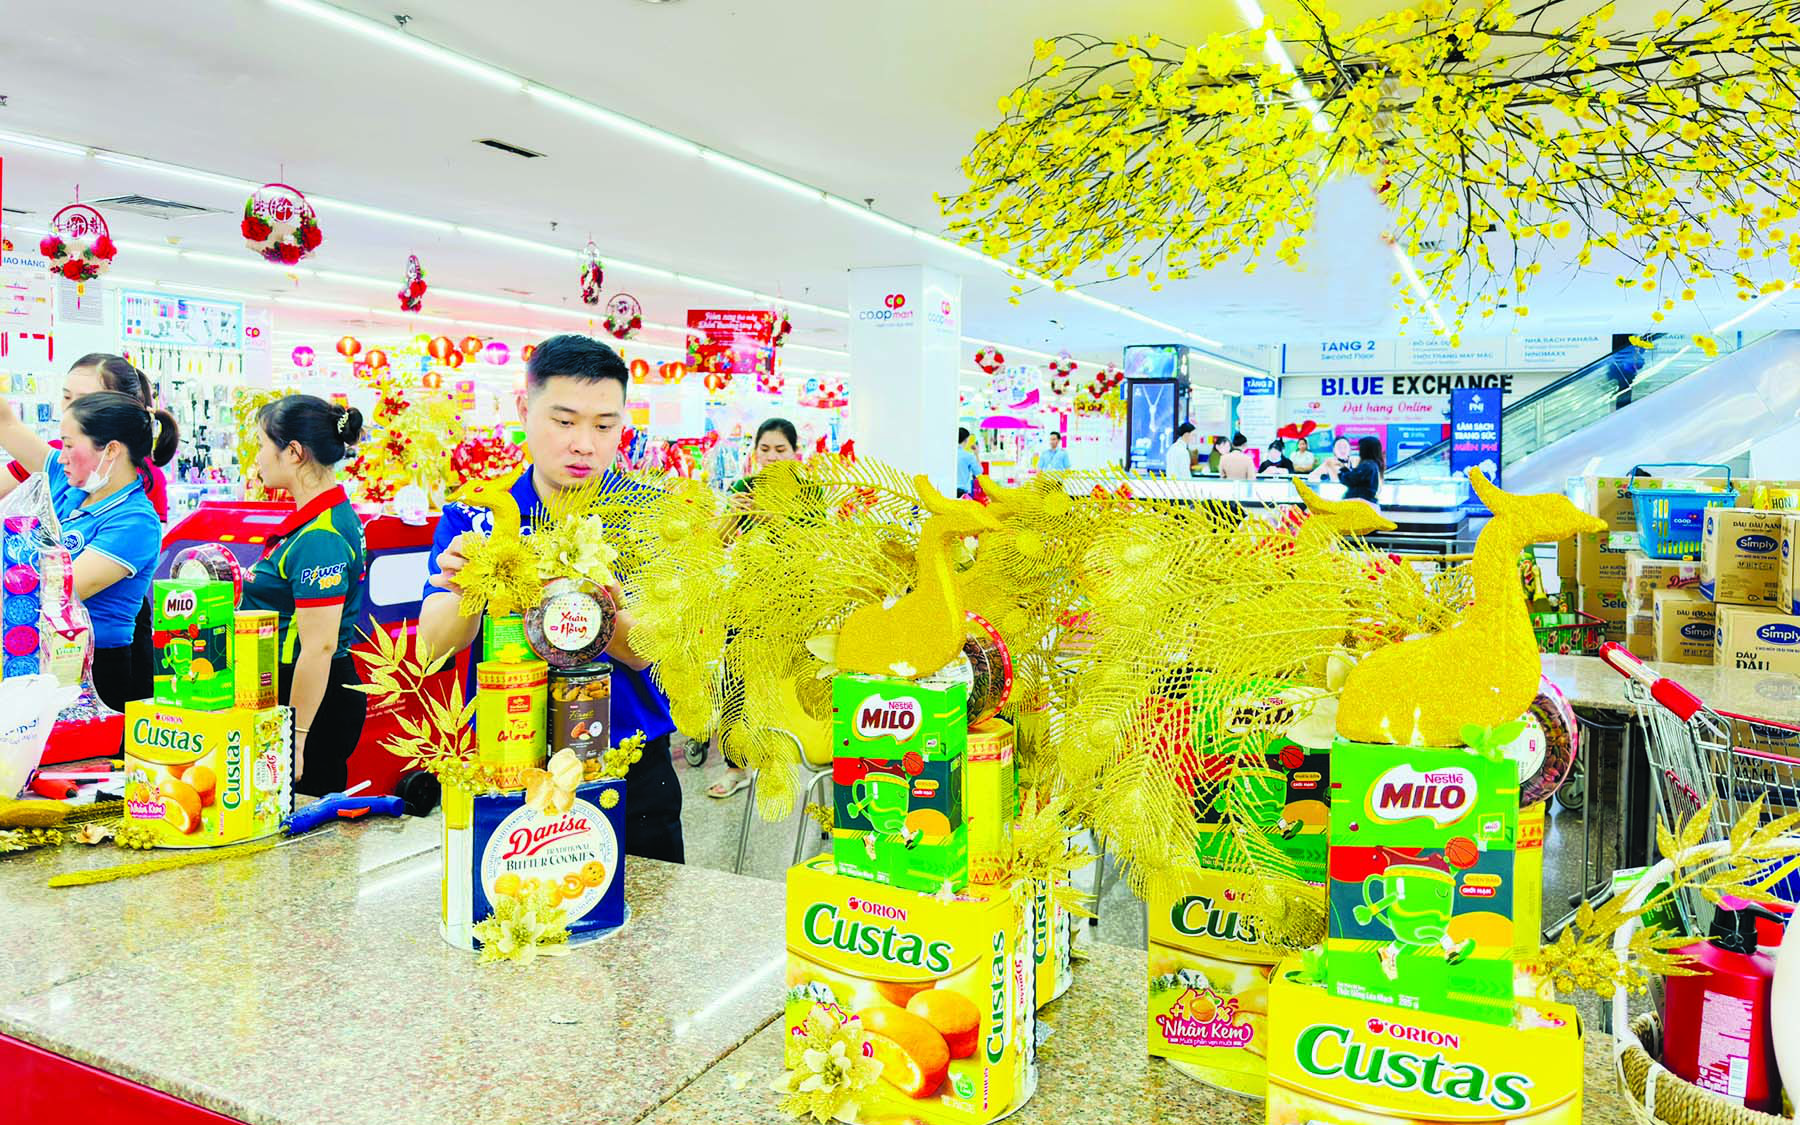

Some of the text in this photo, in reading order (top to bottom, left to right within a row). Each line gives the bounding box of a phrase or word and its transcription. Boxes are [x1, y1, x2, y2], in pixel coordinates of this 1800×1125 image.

[1367, 340, 1376, 351] 2
[1321, 374, 1514, 396] BLUE EXCHANGE
[1740, 537, 1775, 549] Simply
[301, 563, 346, 584] Power
[320, 574, 341, 590] 100
[167, 599, 194, 612] MILO
[861, 708, 915, 730] MILO
[133, 718, 204, 754] Custas
[222, 730, 241, 810] Custas
[1424, 773, 1464, 785] Nestlé
[1379, 783, 1466, 810] MILO
[502, 814, 592, 860] Danisa
[862, 901, 907, 921] ORION
[803, 903, 952, 973] Custas
[987, 930, 1005, 1065] Custas
[1164, 1019, 1252, 1041] Nhân Kem
[1388, 1024, 1459, 1049] ORION
[1296, 1024, 1529, 1112] Custas
